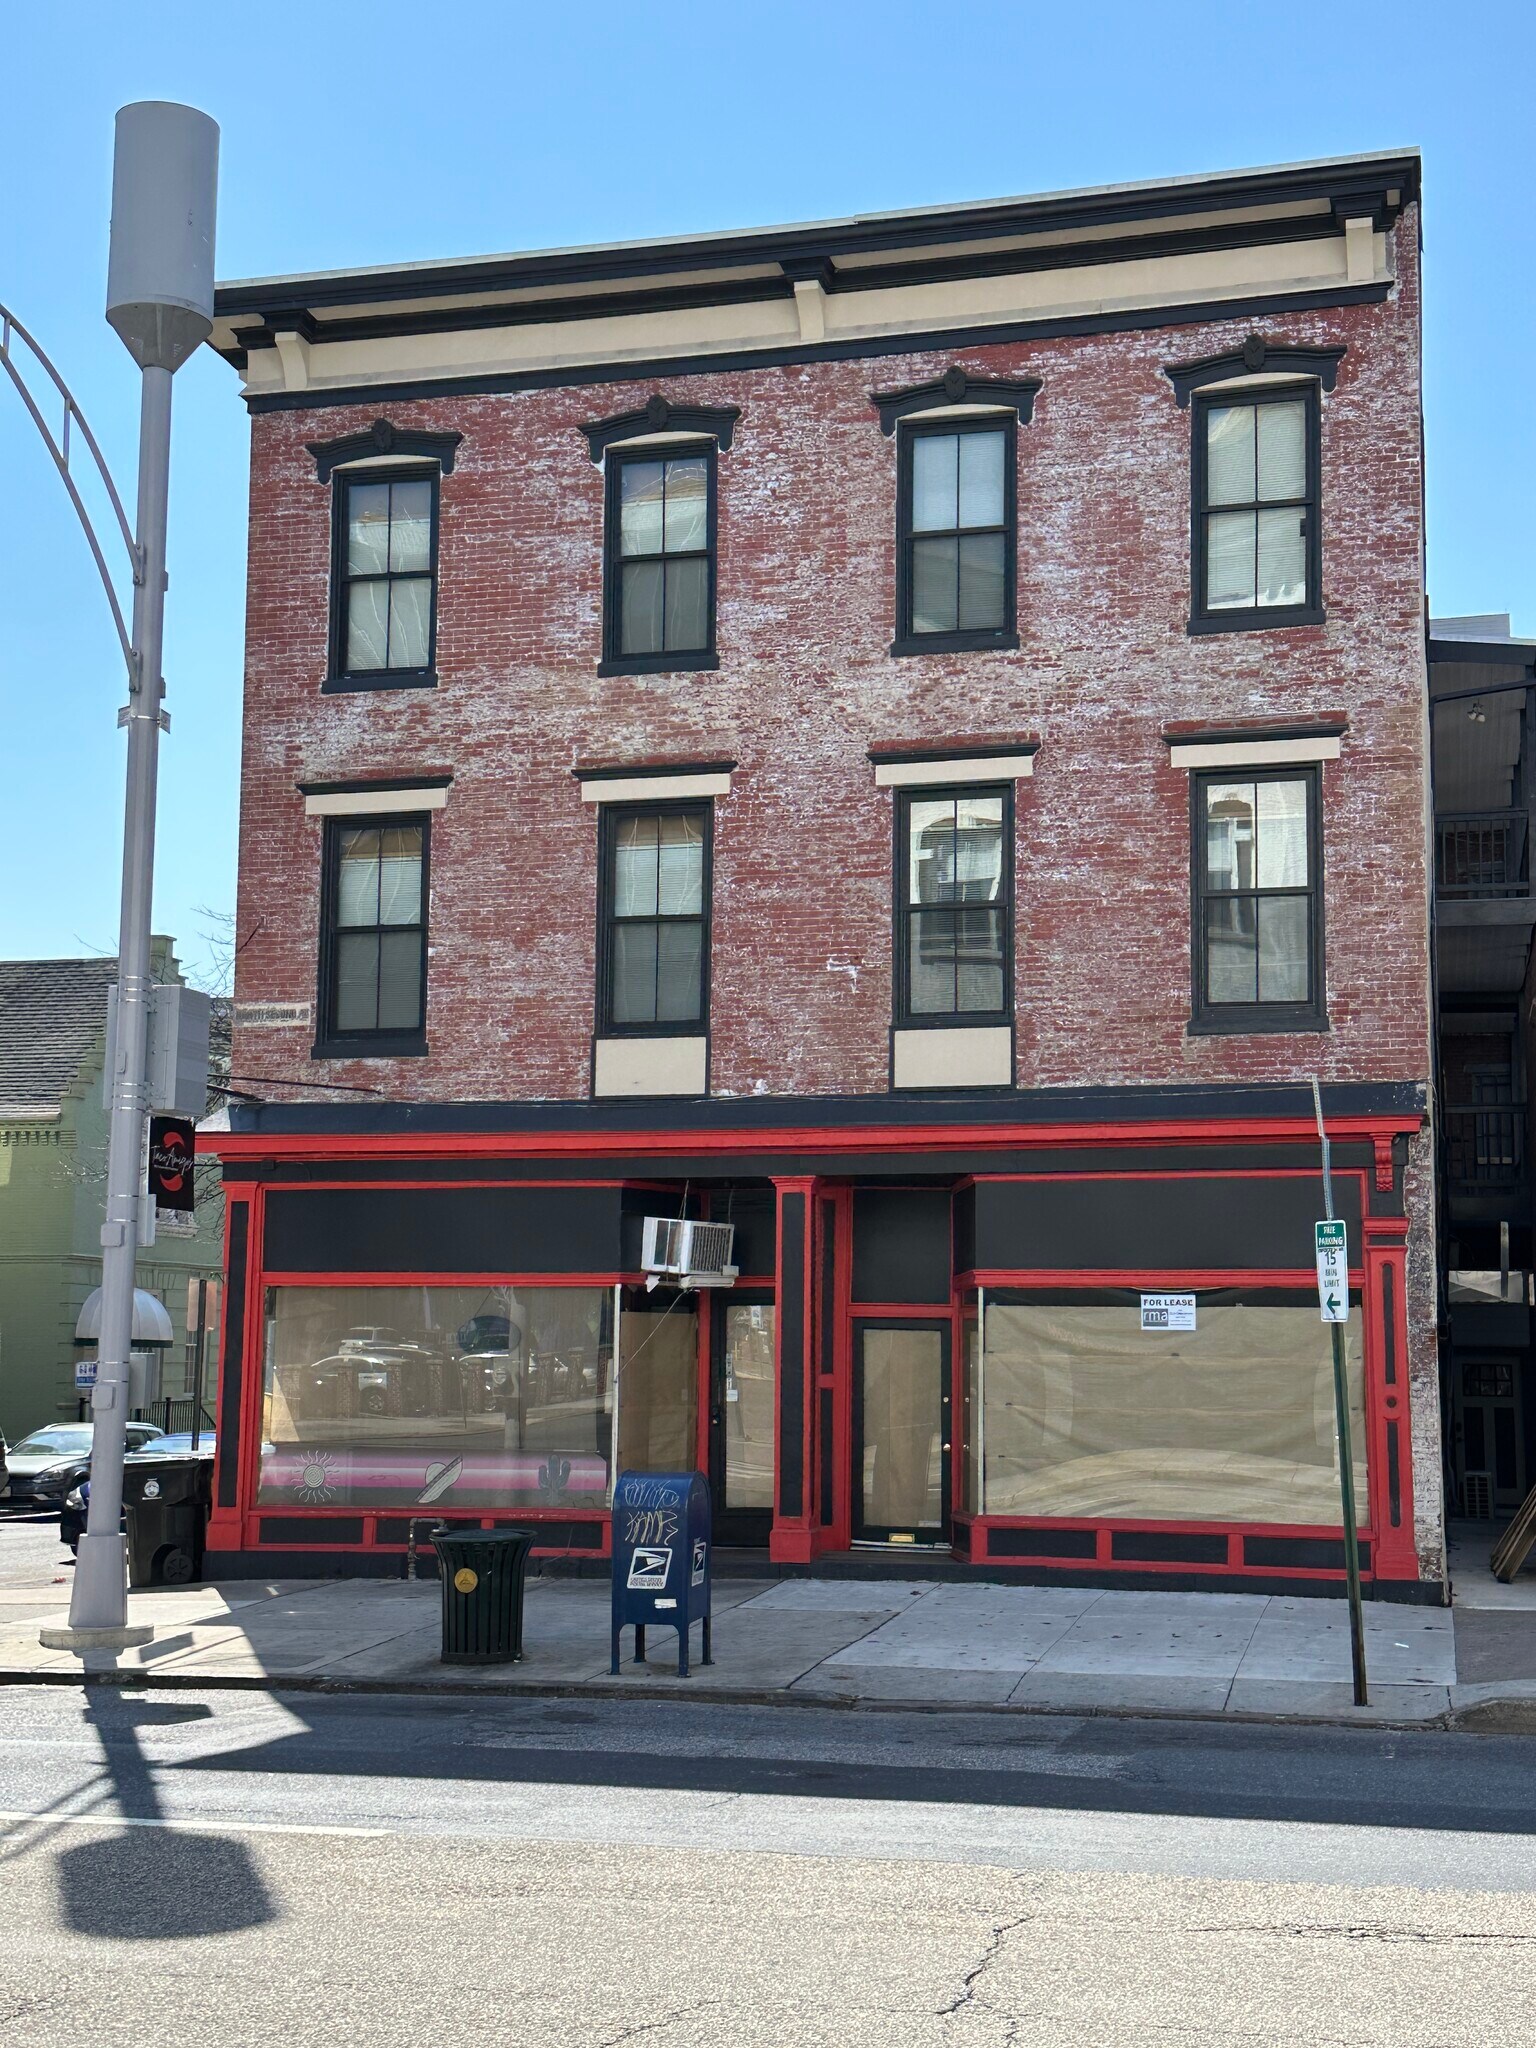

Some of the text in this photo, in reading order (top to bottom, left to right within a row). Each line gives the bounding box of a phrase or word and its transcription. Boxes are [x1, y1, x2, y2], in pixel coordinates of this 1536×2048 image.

[1318, 1237, 1344, 1246] PARKING
[1325, 1252, 1337, 1266] 15
[1143, 1298, 1193, 1306] FOR LEASE
